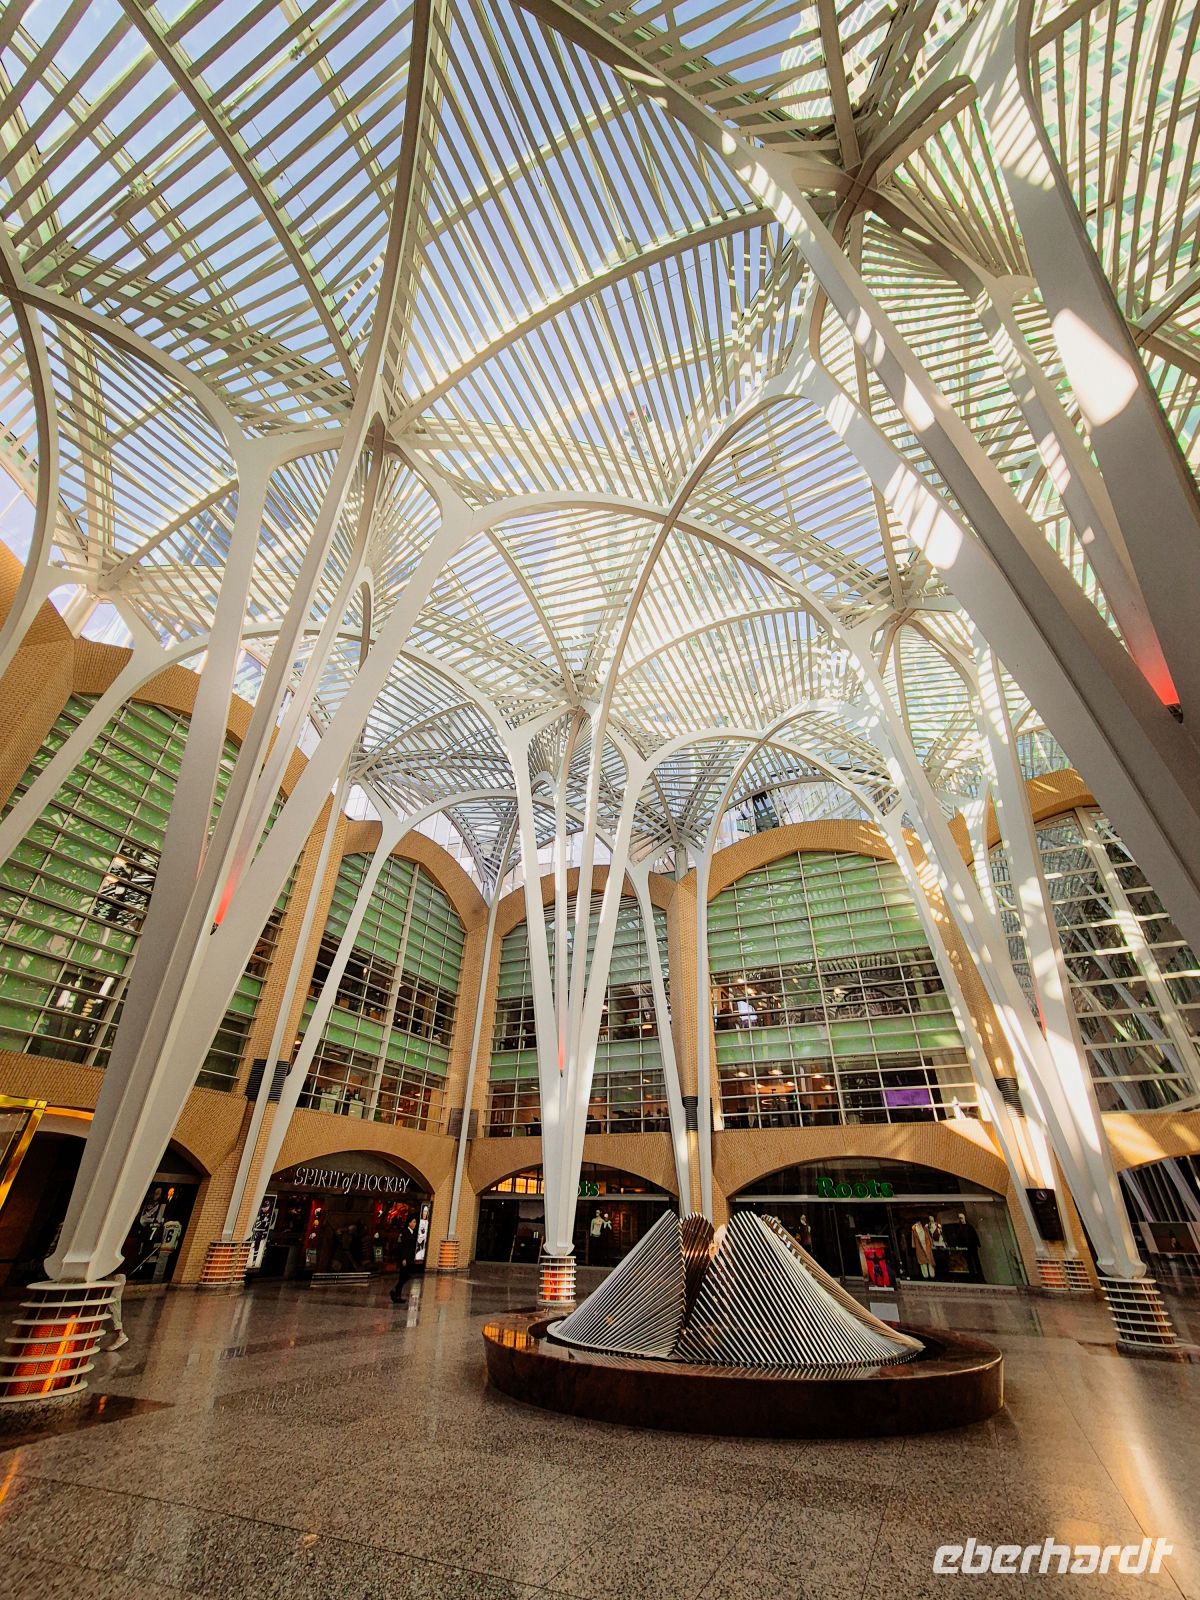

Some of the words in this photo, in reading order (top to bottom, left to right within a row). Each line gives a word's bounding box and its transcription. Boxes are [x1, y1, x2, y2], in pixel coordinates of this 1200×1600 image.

[294, 1167, 344, 1189] SPIRIT
[342, 1172, 357, 1194] of
[355, 1173, 410, 1193] HOCKEY
[816, 1176, 894, 1198] Roots
